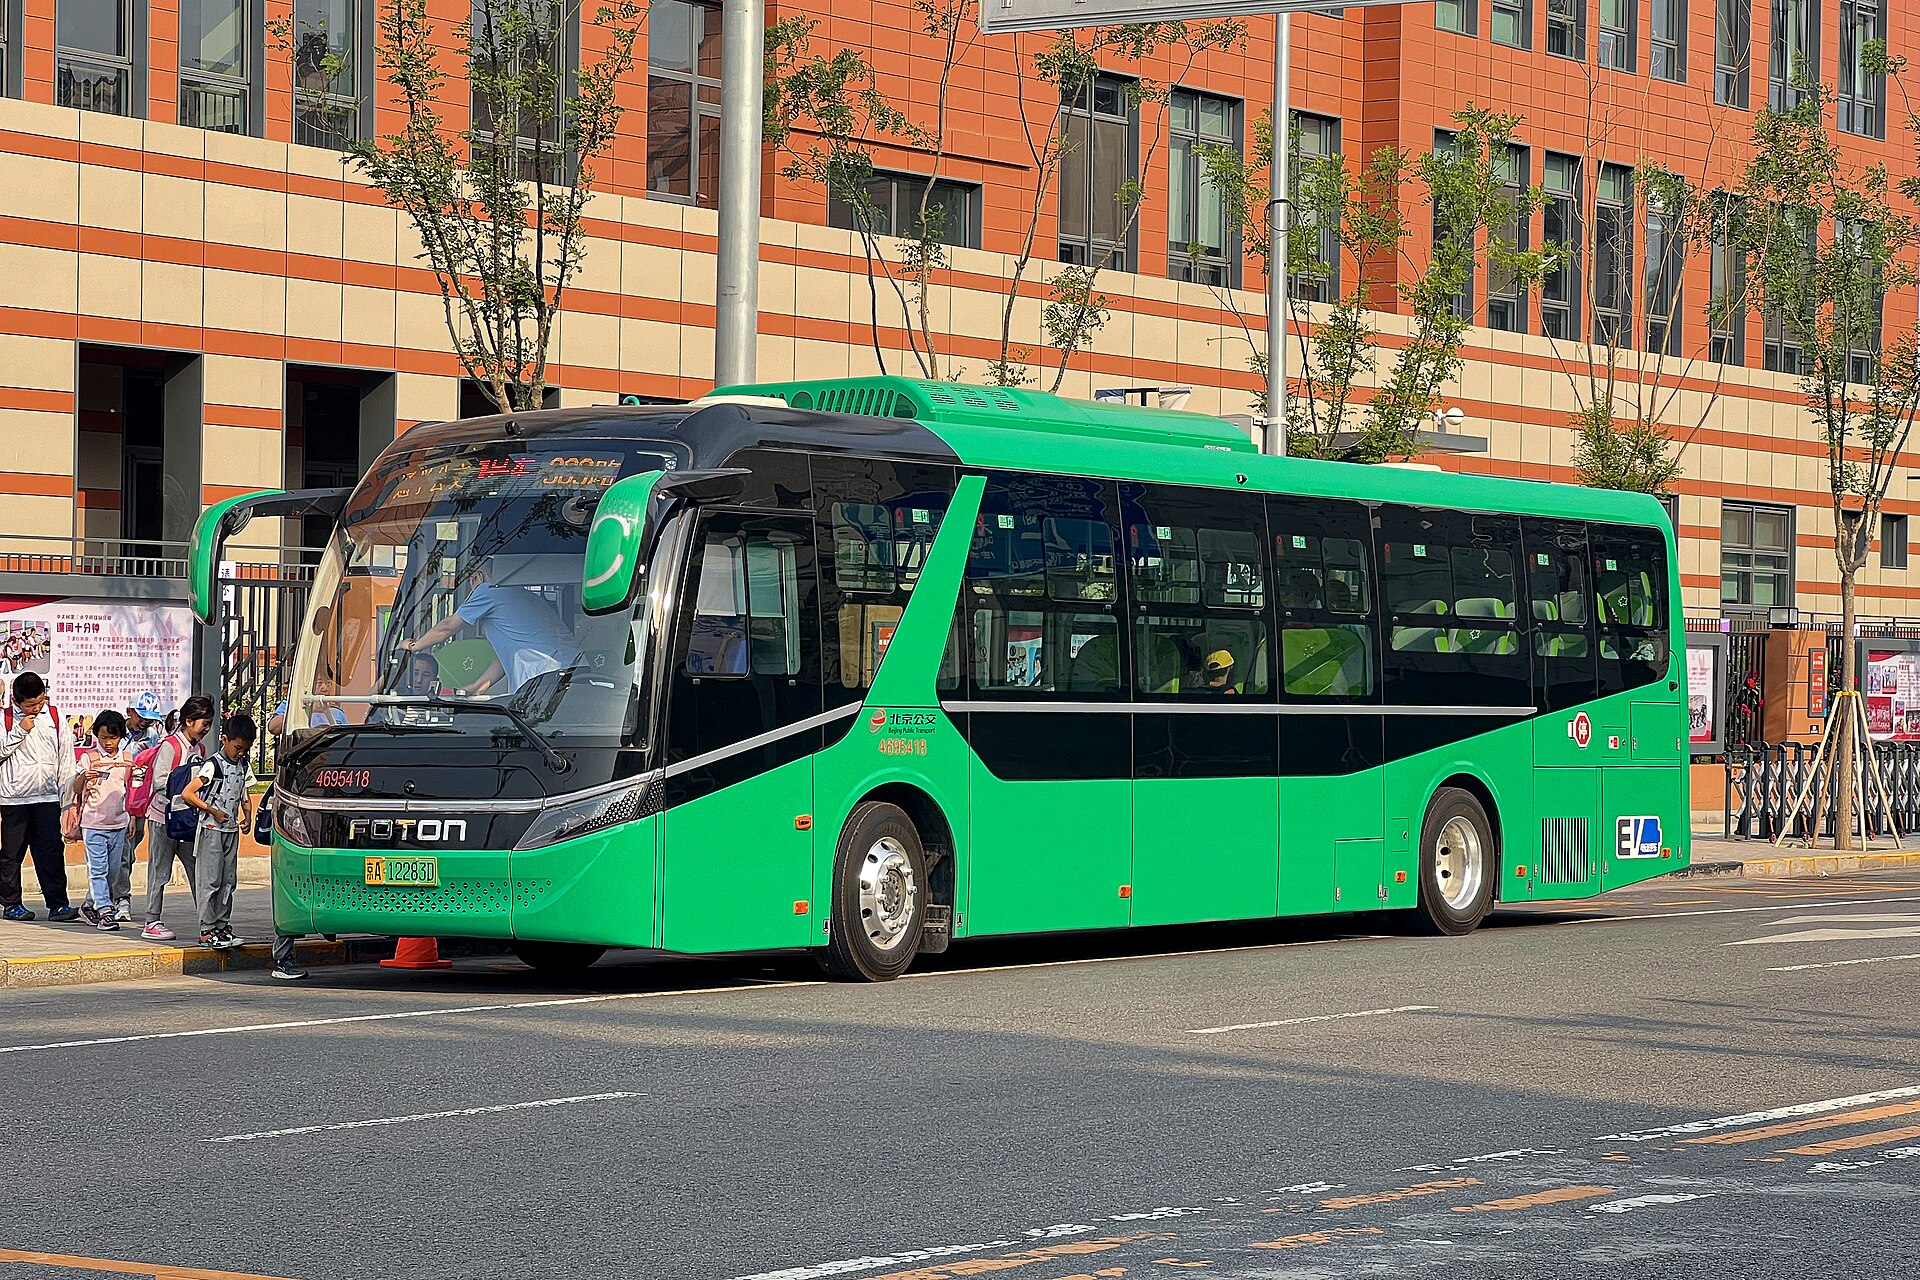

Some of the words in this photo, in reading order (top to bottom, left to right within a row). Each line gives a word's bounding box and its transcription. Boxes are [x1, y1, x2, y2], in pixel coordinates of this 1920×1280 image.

[889, 713, 937, 725] 北京公交
[888, 727, 903, 736] Beijing
[916, 727, 936, 735] Transport
[879, 738, 927, 756] 4695418
[316, 770, 370, 788] 4695418
[349, 819, 467, 841] FOTON
